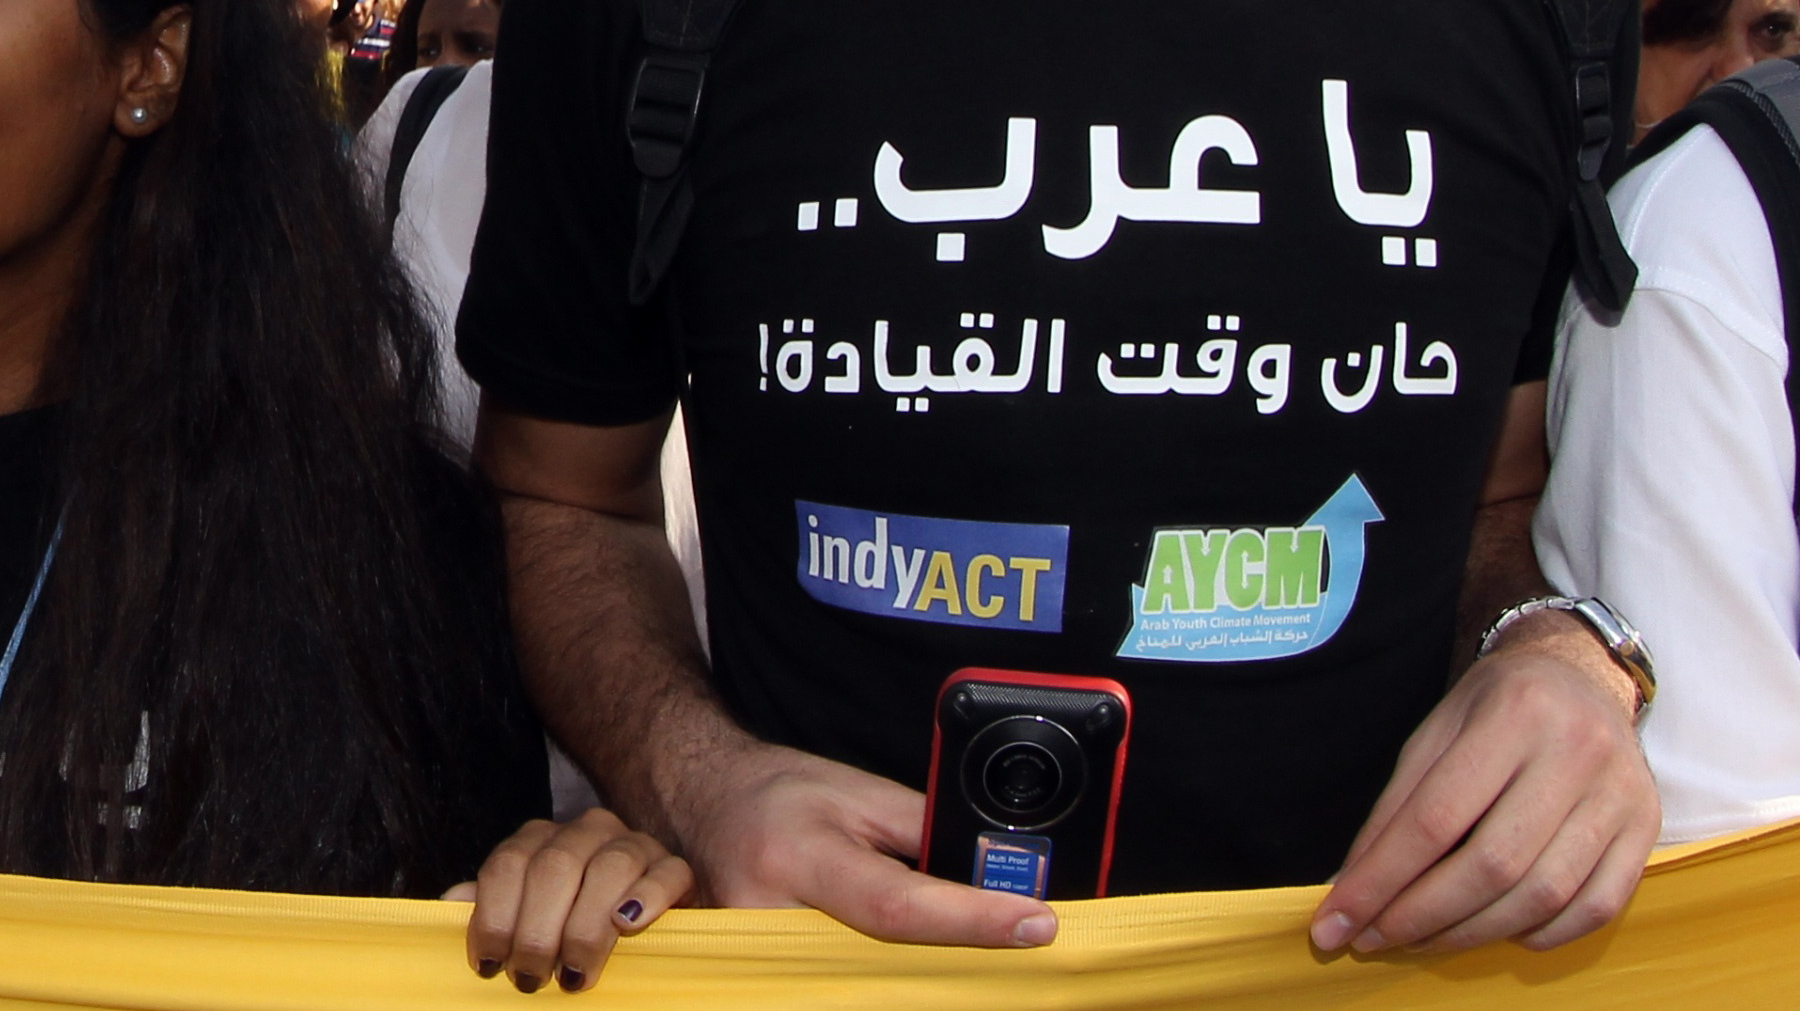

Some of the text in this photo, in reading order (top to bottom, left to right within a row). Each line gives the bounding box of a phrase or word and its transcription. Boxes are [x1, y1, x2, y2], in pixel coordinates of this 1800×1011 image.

[1322, 80, 1437, 267] يا
[758, 312, 1458, 415] حان وقت القيادة!
[808, 514, 1052, 622] indyACT
[1139, 525, 1326, 615] AYCM
[1140, 613, 1312, 631] Arab Youth Climate Movement
[983, 879, 998, 888] Full
[999, 881, 1012, 889] HD
[1008, 856, 1029, 865] Proof
